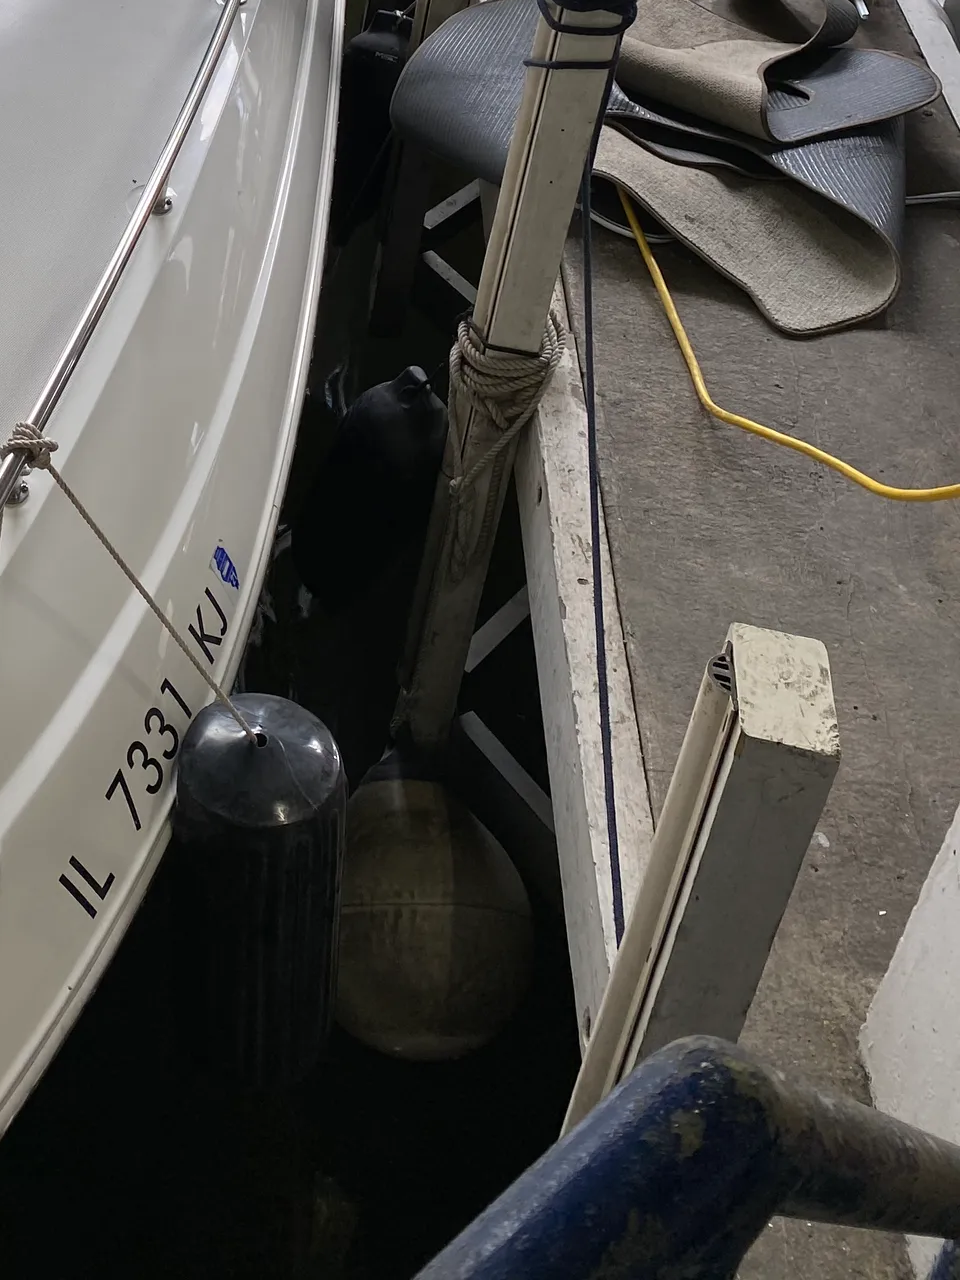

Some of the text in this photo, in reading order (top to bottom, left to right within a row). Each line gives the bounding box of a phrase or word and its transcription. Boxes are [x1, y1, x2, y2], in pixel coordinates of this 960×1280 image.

[58, 855, 115, 919] IL
[105, 677, 192, 831] 7331
[187, 586, 228, 665] KJ
